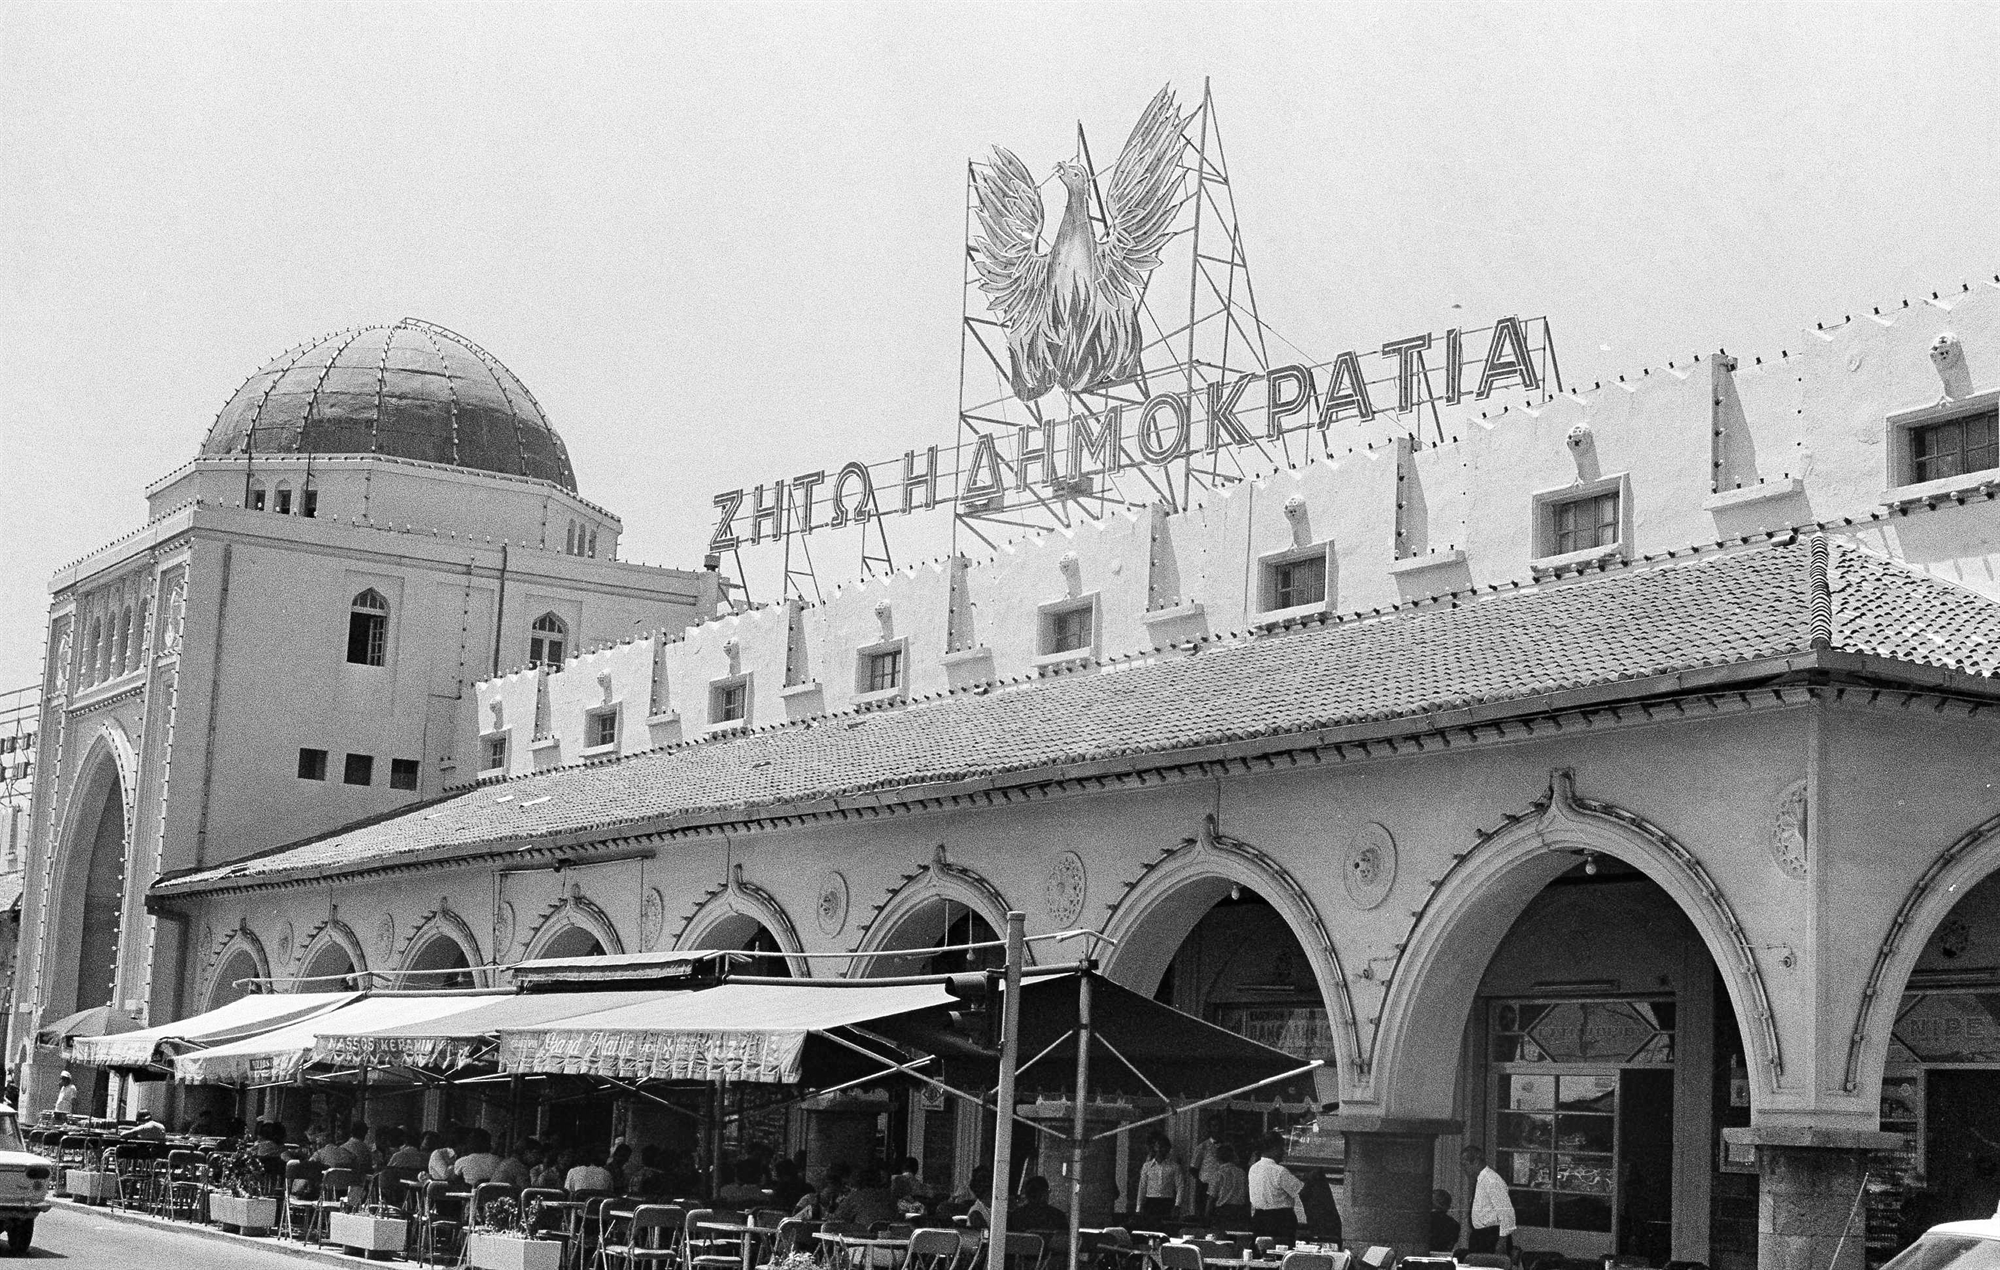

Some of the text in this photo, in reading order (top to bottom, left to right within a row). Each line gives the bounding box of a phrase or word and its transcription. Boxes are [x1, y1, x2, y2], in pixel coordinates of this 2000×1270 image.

[709, 314, 1541, 553] ΖΗΤΩ Η ΔΗΜΟΚΡΑΤΙΑ
[328, 1036, 375, 1052] NASSOS
